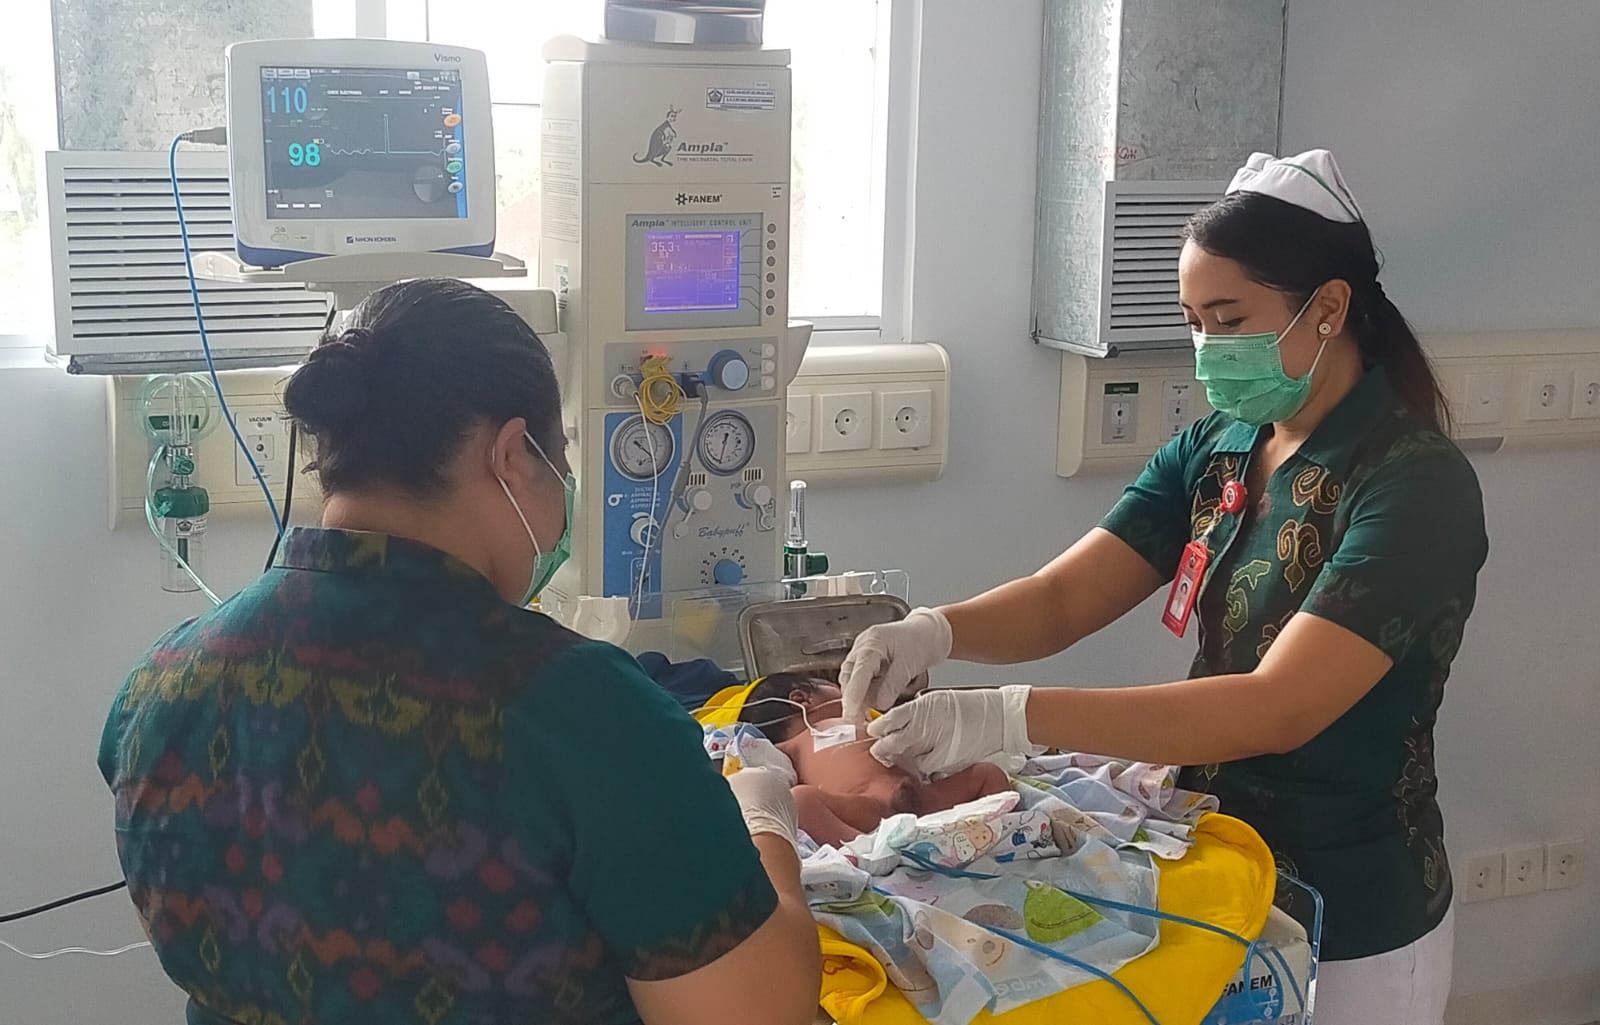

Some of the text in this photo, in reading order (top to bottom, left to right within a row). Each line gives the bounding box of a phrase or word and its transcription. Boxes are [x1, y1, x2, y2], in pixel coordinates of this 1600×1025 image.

[434, 53, 461, 63] Vismo
[267, 86, 307, 113] 110
[288, 143, 320, 166] 98
[688, 195, 720, 203] FANEM
